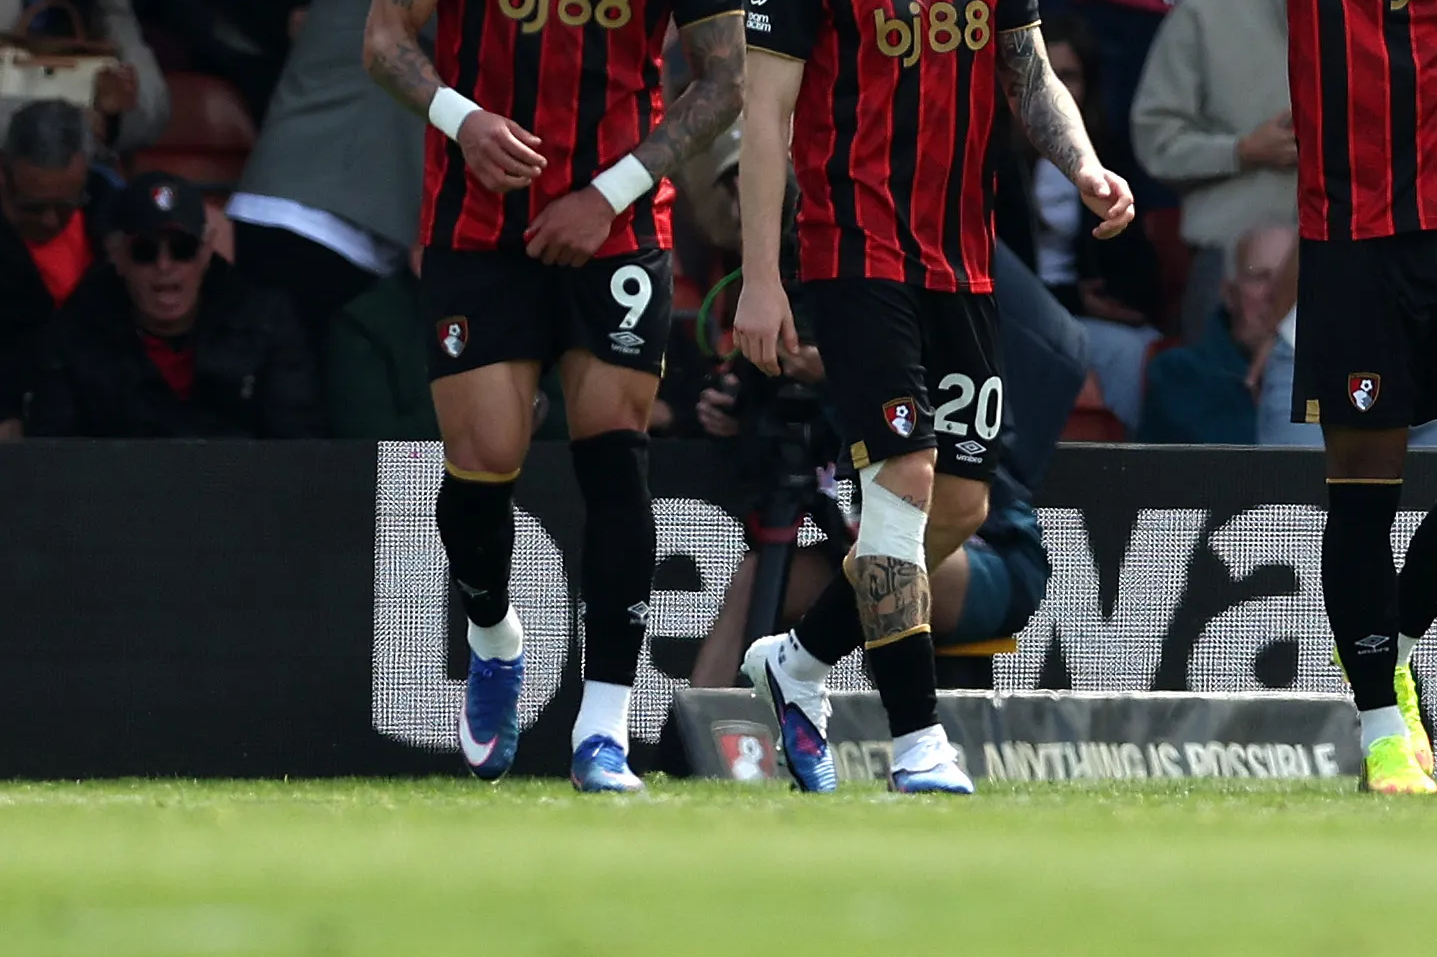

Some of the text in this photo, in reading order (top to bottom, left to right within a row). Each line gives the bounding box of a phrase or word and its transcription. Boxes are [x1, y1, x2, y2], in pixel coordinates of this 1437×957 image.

[874, 0, 990, 68] bj88
[610, 264, 653, 329] 9
[933, 373, 1003, 440] 20
[956, 453, 984, 464] umbro
[984, 742, 1145, 782] ANYTHING
[1147, 742, 1184, 780] IS
